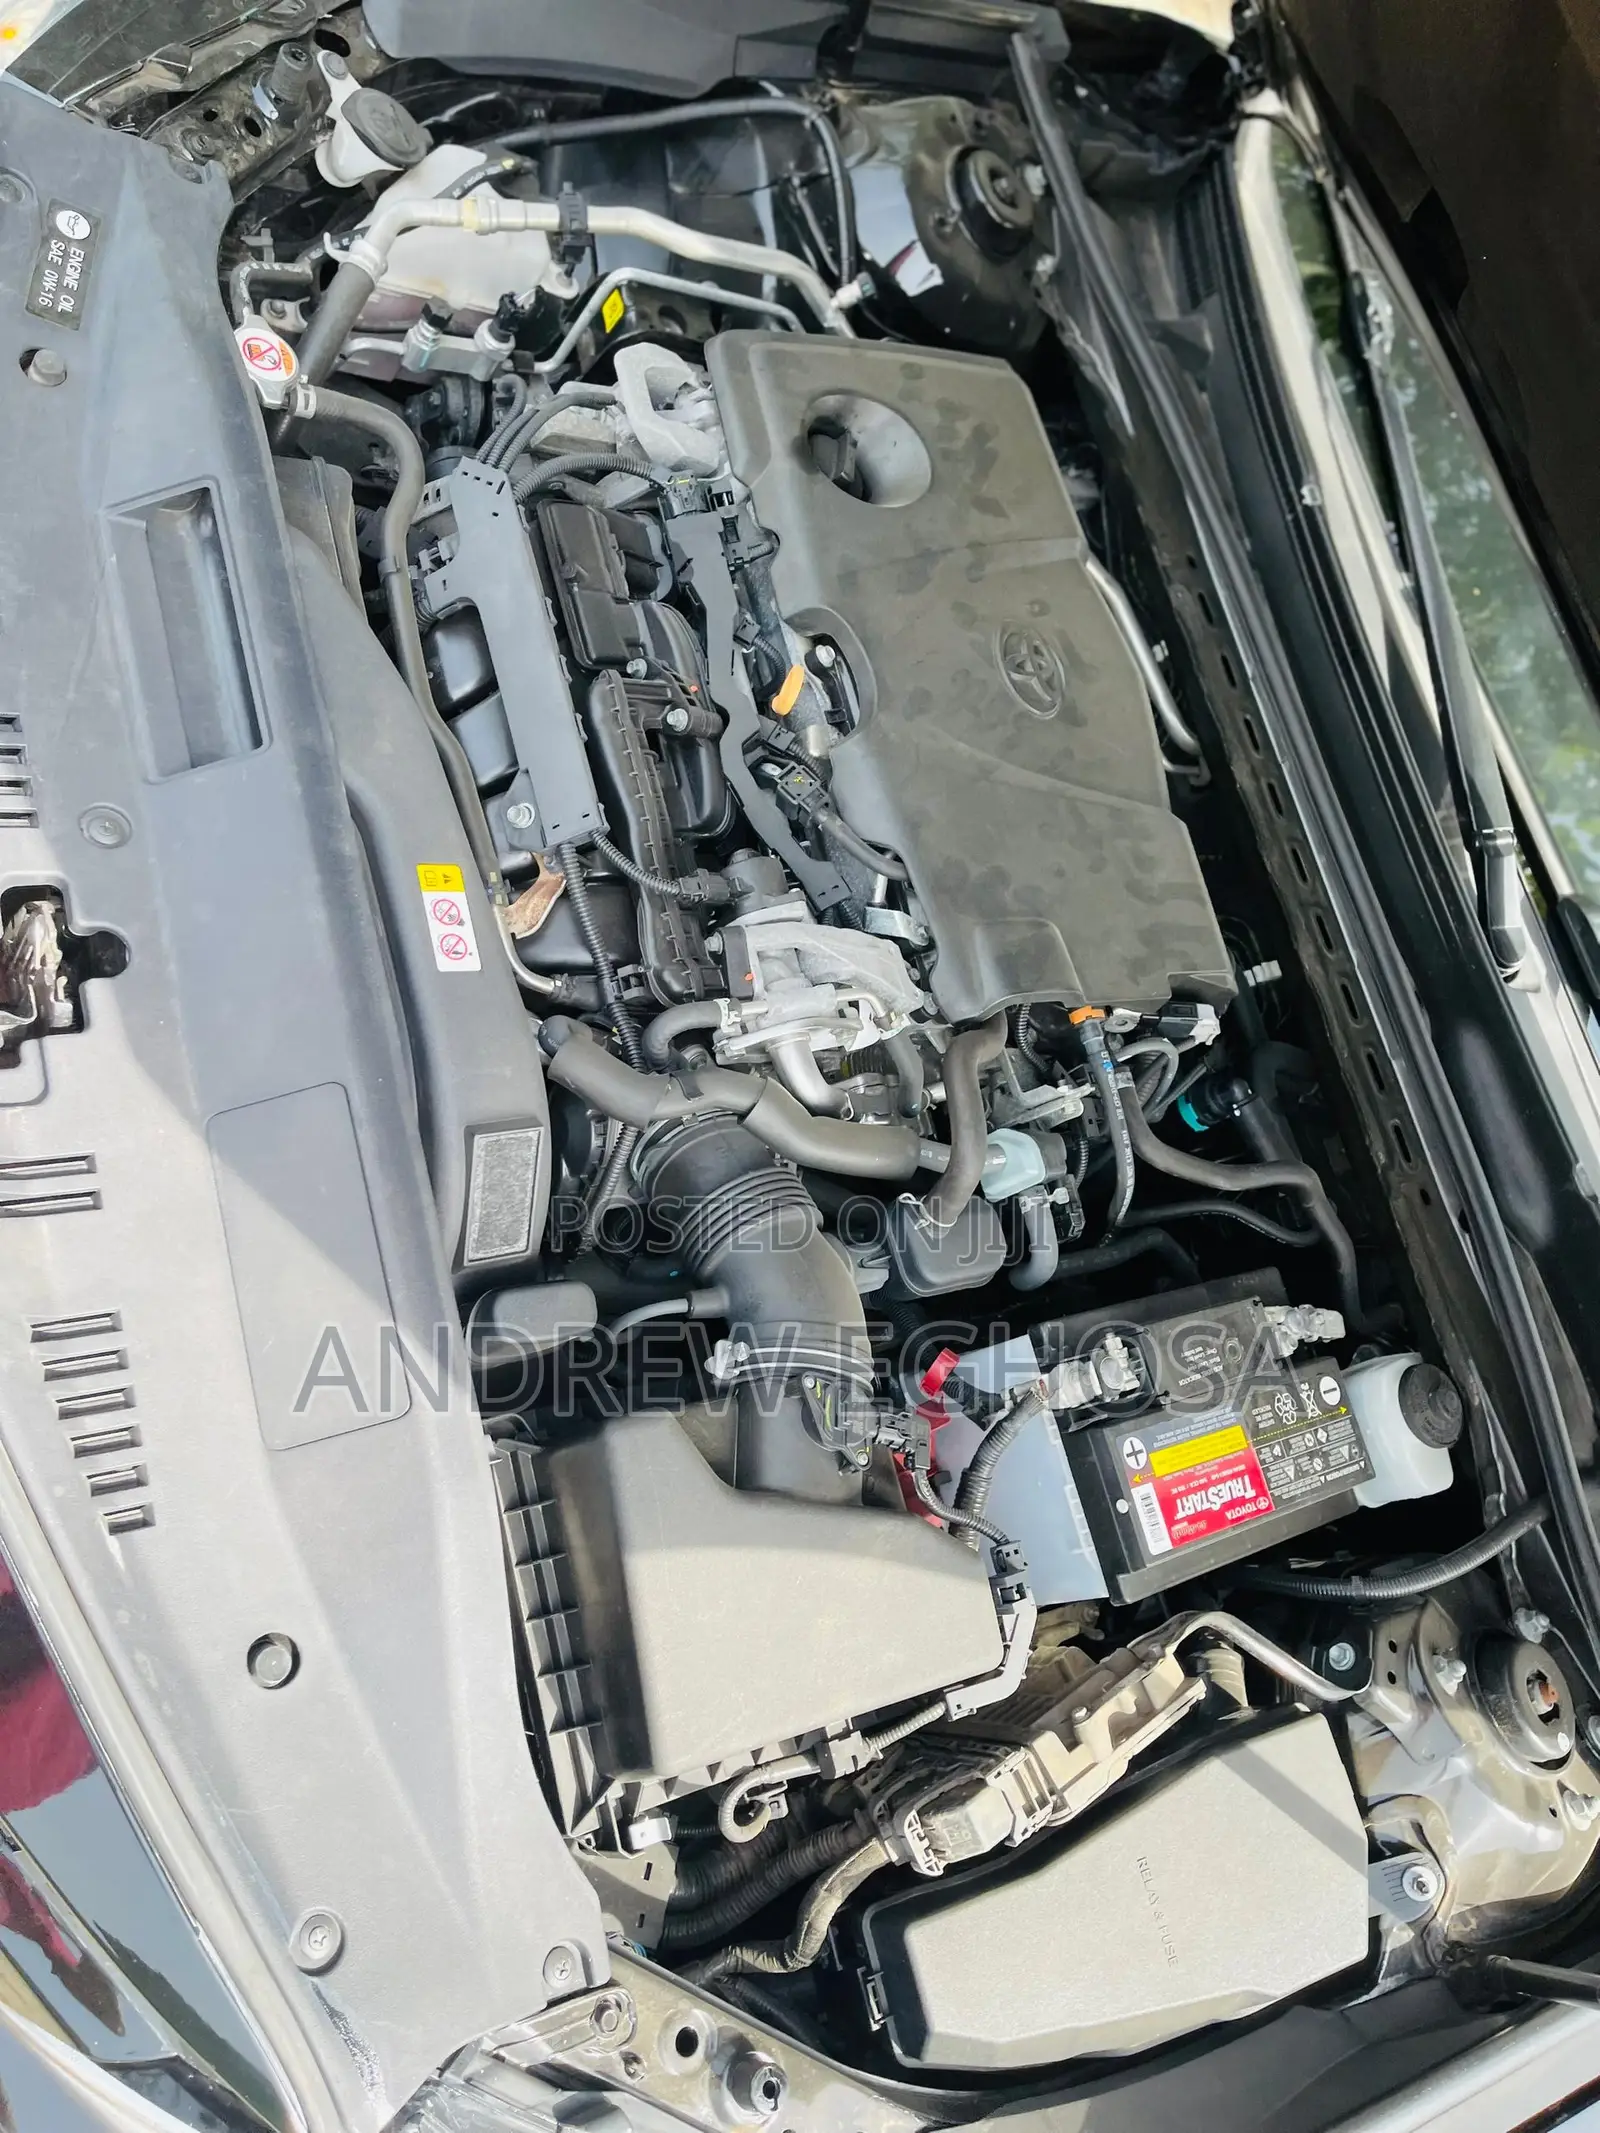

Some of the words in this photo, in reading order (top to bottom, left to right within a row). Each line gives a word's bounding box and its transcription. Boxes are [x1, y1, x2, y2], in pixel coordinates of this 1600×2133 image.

[47, 239, 66, 266] SAE
[63, 247, 85, 291] ENGINE
[38, 269, 59, 308] 0W-16
[57, 294, 75, 313] OIL
[1225, 1501, 1257, 1520] TOYOTA
[1136, 1856, 1160, 1906] RELAY
[1153, 1911, 1165, 1921] &
[1158, 1924, 1179, 1968] FUSE
